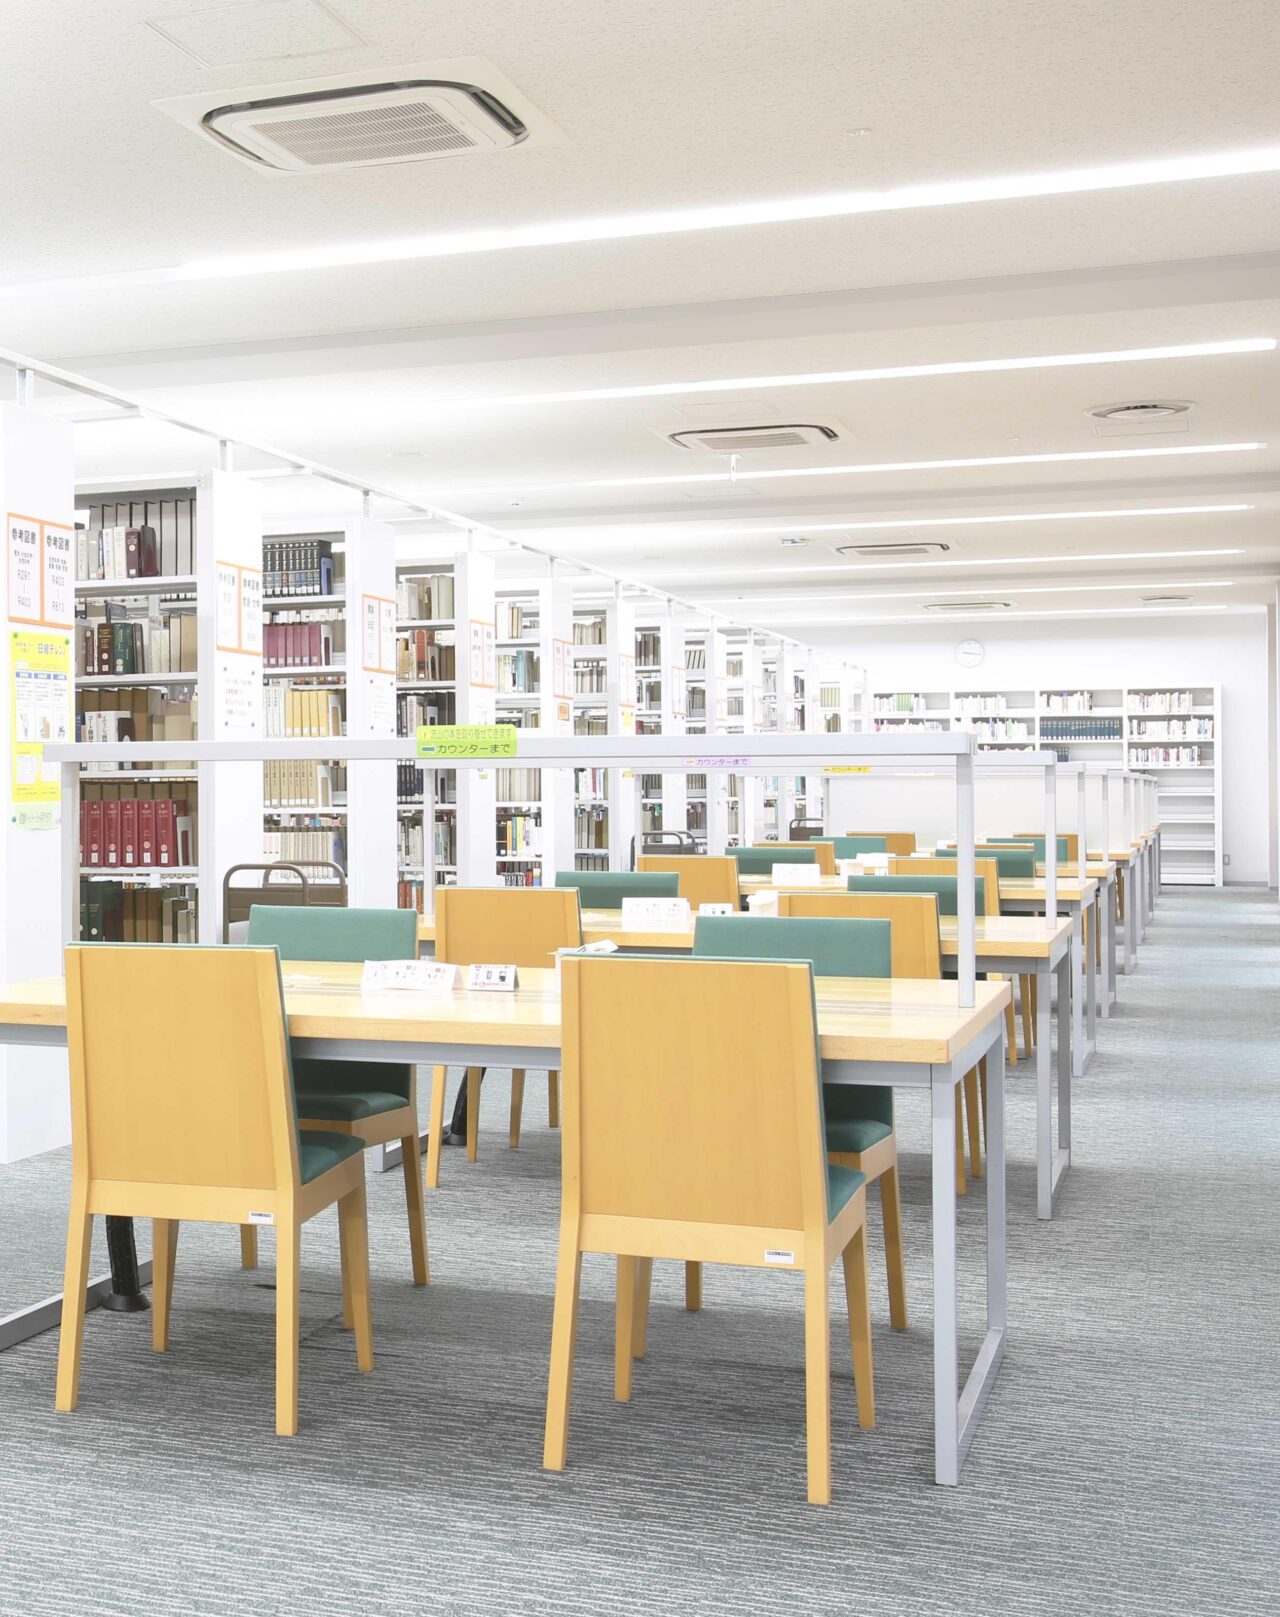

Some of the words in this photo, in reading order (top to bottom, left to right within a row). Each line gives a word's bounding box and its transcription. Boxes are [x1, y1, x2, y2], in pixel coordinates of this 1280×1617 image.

[11, 528, 36, 544] 参考図書
[46, 535, 70, 551] 参考図書
[38, 642, 67, 656] 日経テレコン
[438, 744, 511, 754] カウンターまで
[696, 757, 748, 766] カウンターまで
